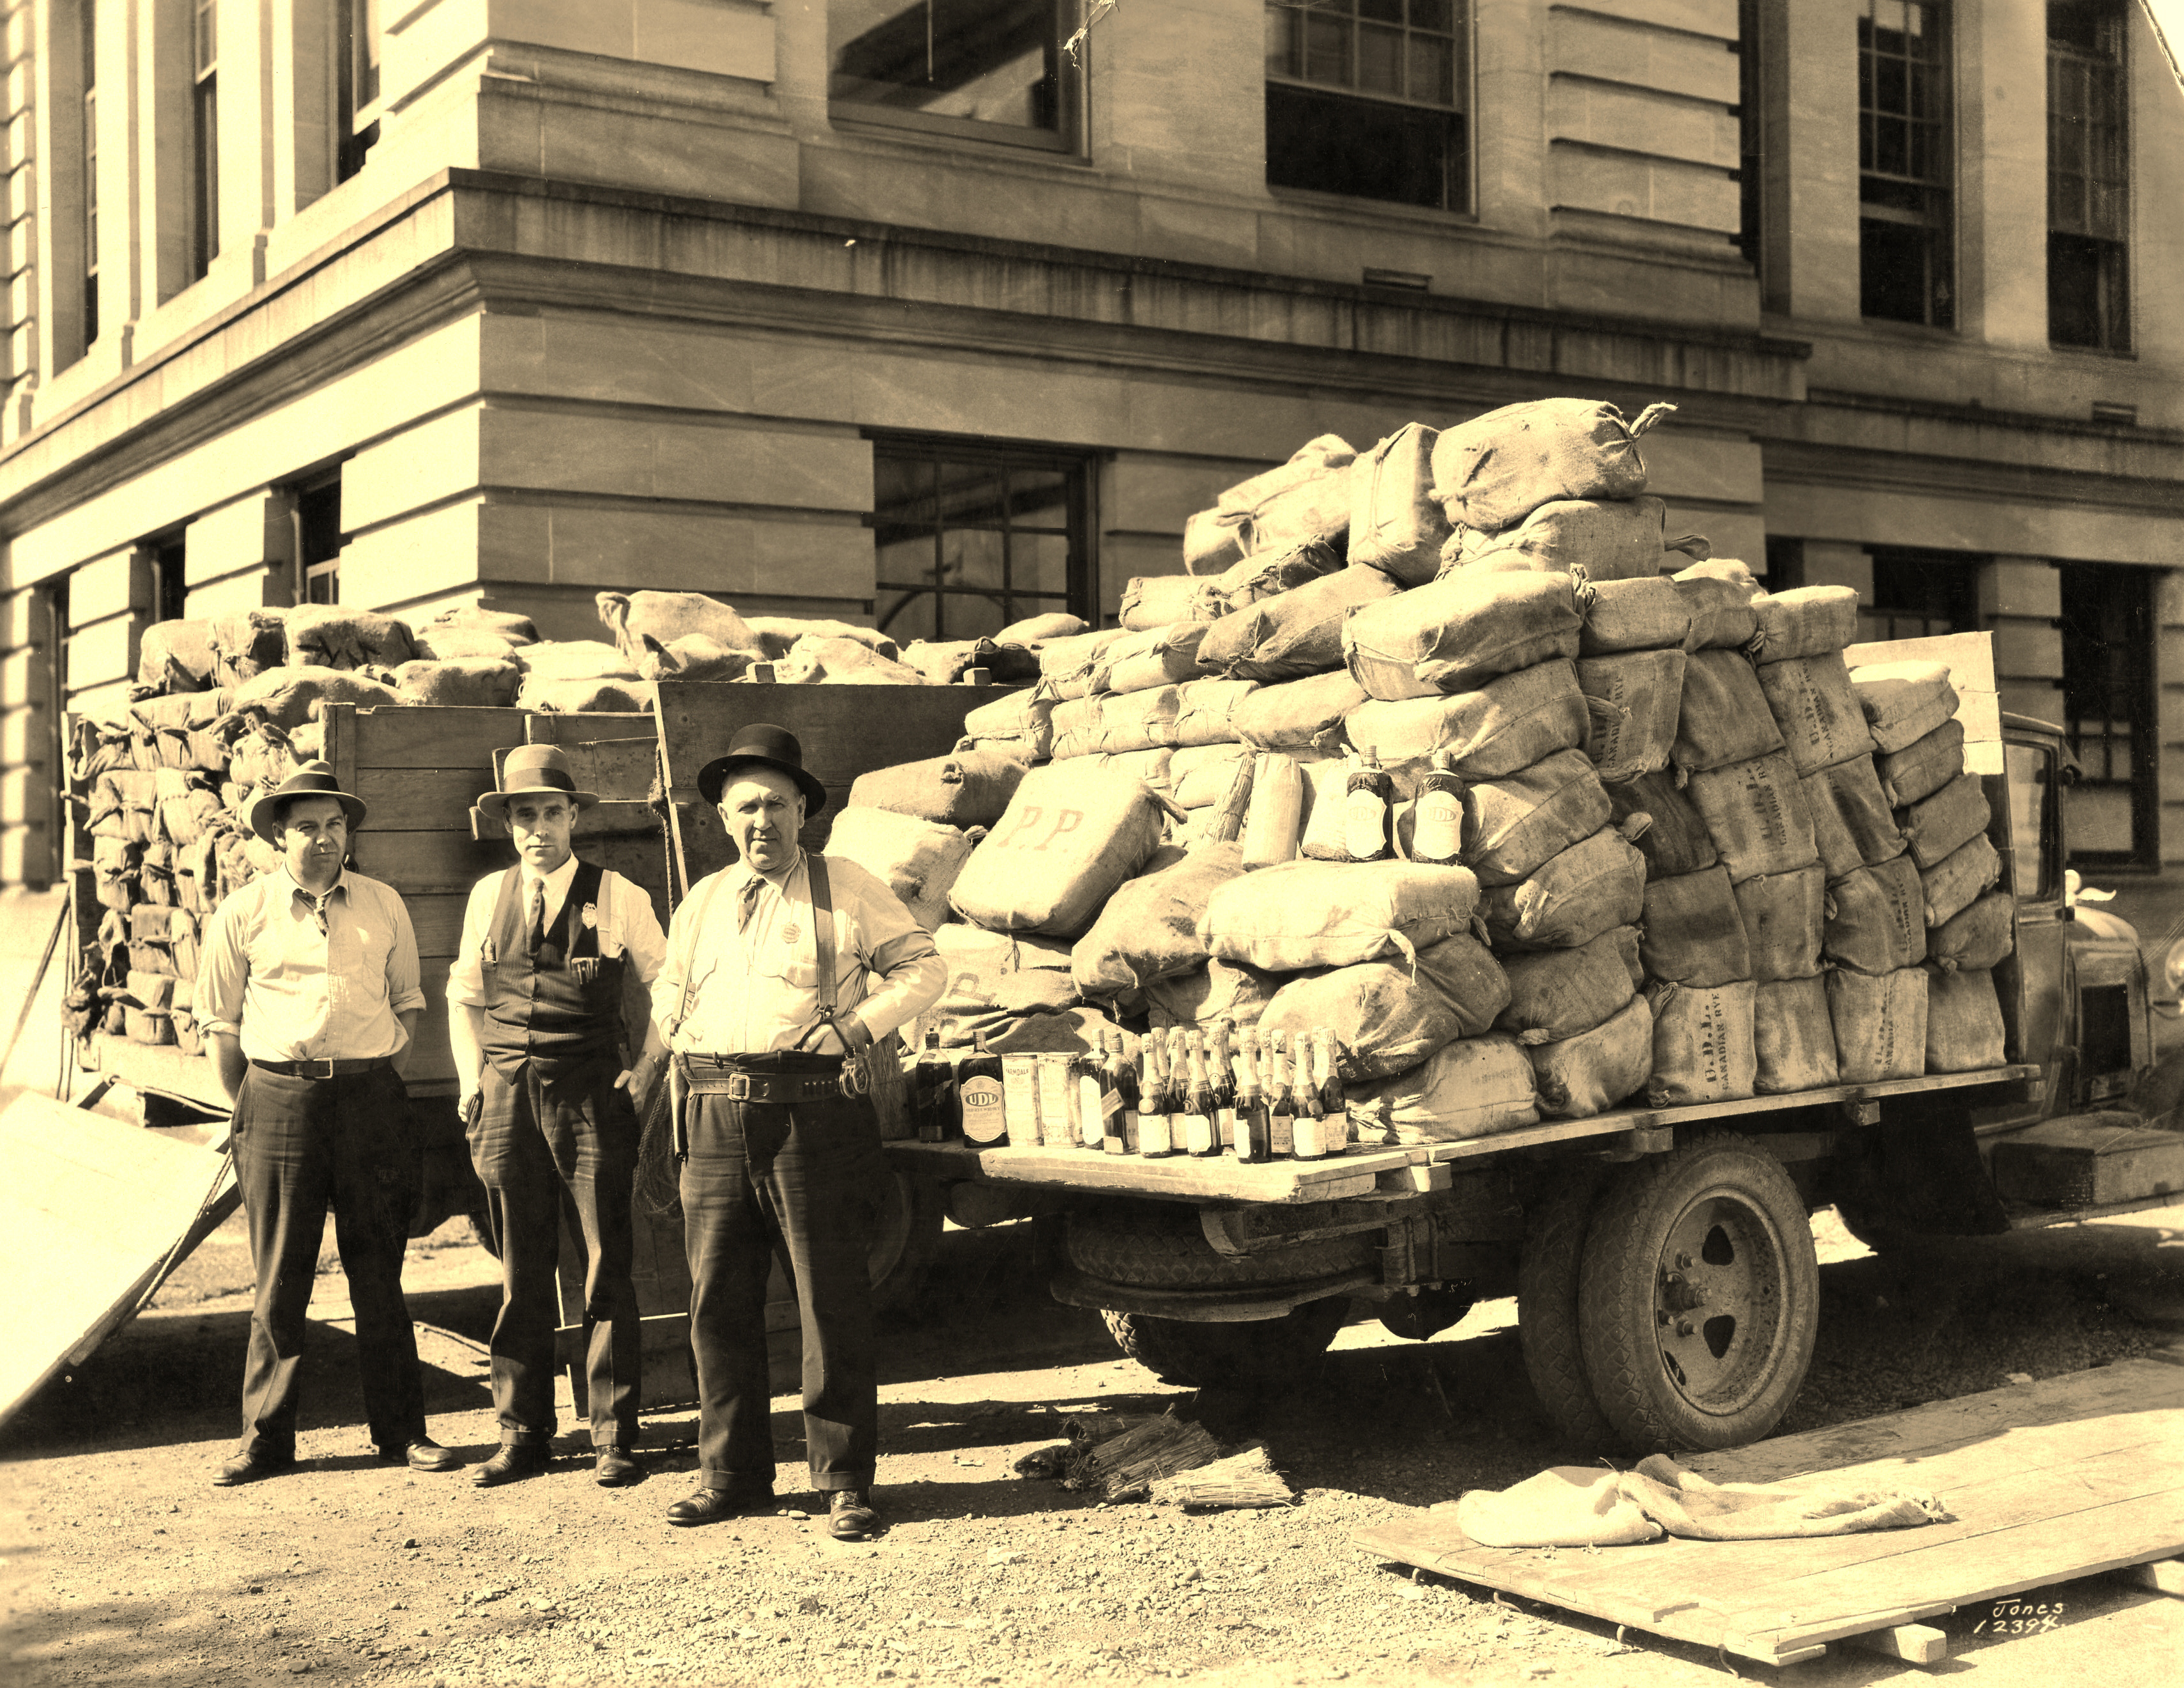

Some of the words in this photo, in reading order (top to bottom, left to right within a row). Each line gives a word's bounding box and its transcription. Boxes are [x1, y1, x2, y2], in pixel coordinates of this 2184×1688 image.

[1810, 688, 1834, 749] CANADIAN
[1764, 784, 1787, 846] CANADIAN
[1712, 993, 1723, 1018] RYE
[1717, 1023, 1729, 1090] CANADIAN
[968, 1093, 997, 1106] UDL
